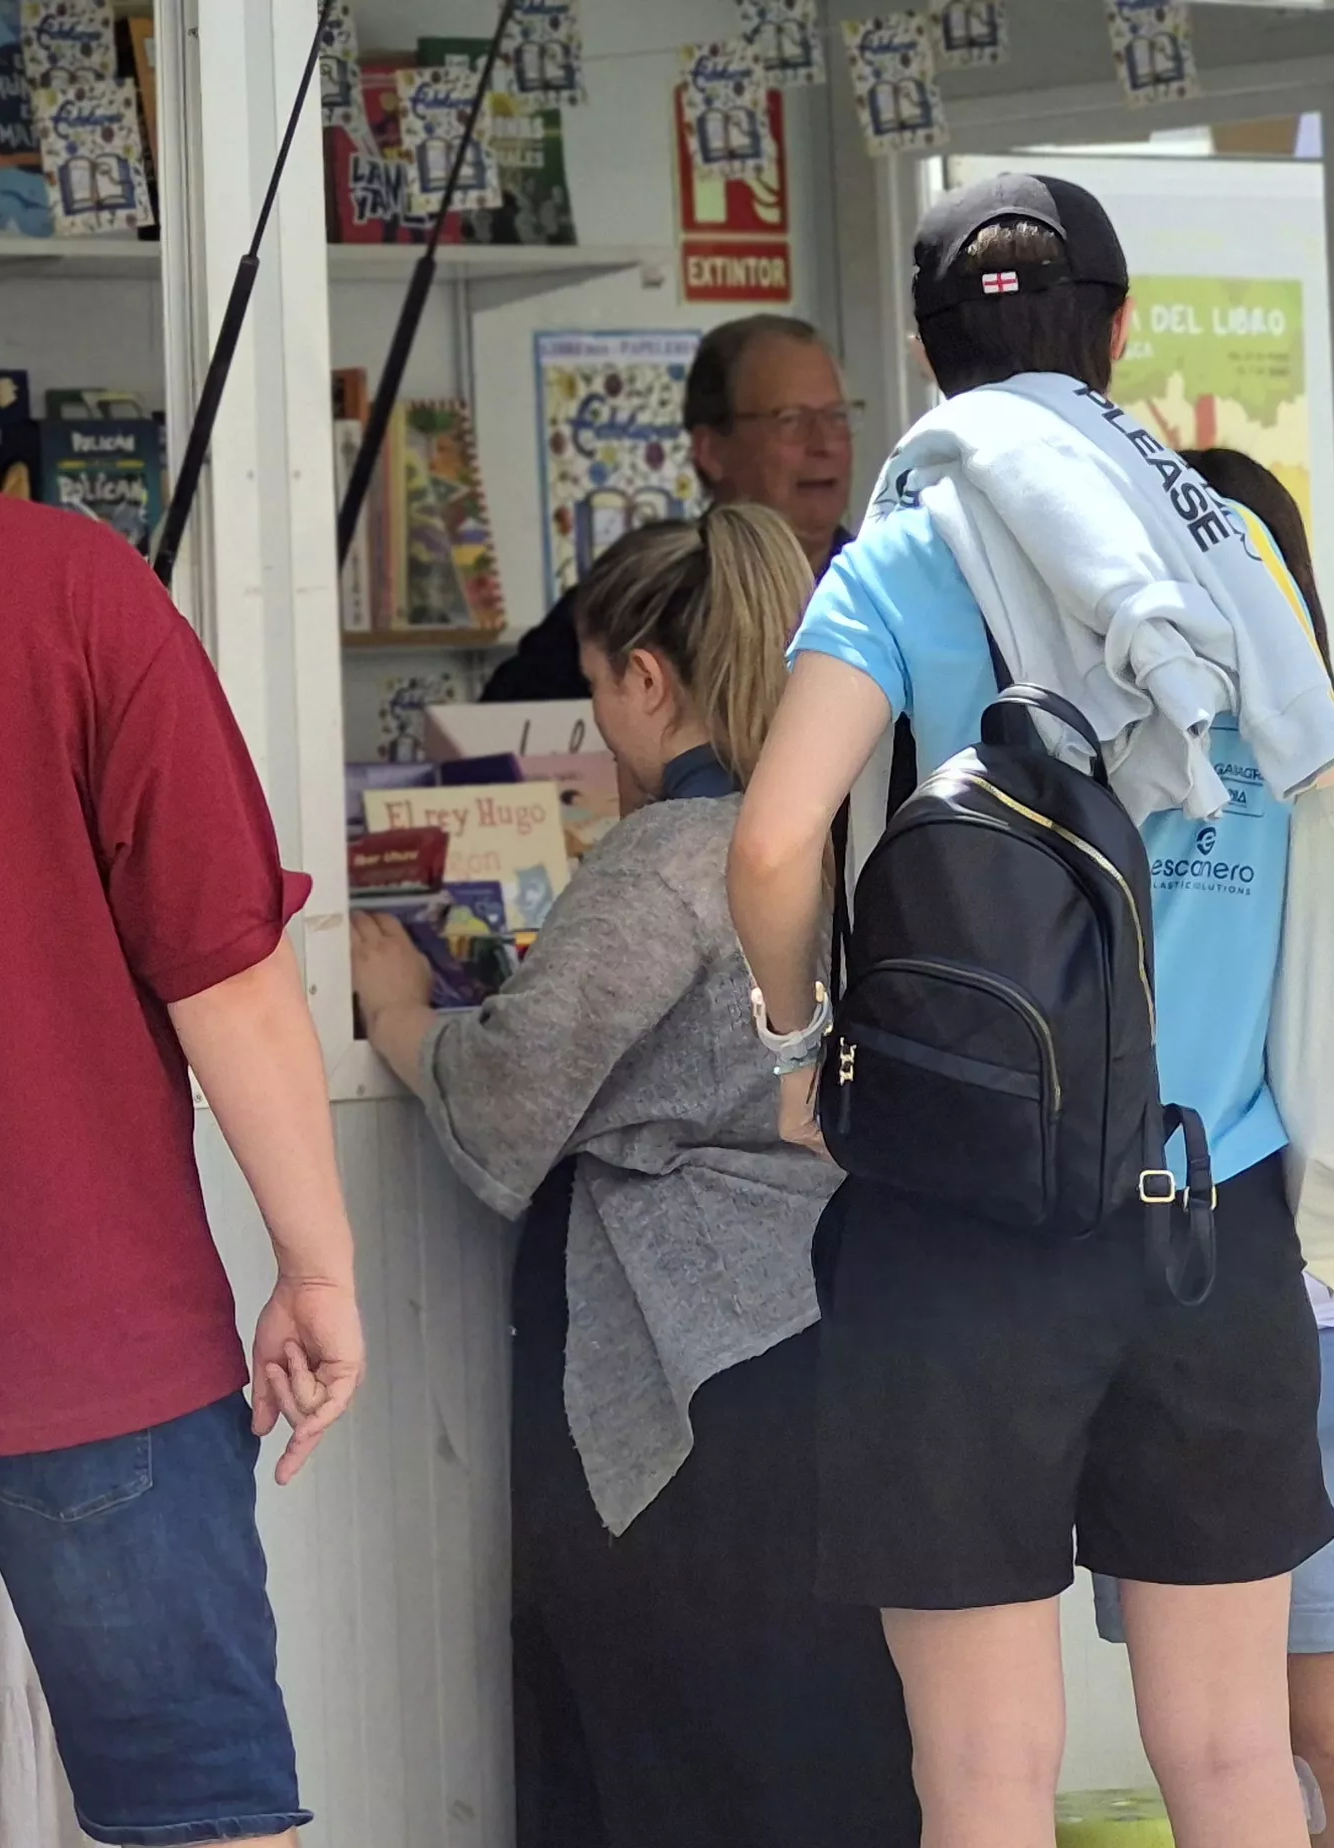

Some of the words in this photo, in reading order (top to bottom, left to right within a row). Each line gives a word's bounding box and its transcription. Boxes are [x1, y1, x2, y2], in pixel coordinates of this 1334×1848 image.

[687, 256, 787, 288] EXTINTOR
[1150, 304, 1204, 335] DEL
[1212, 306, 1286, 337] LIBRO
[1073, 386, 1229, 553] PLEASE
[424, 808, 468, 837] rey
[476, 798, 547, 834] Hugo
[1151, 859, 1254, 883] escanero
